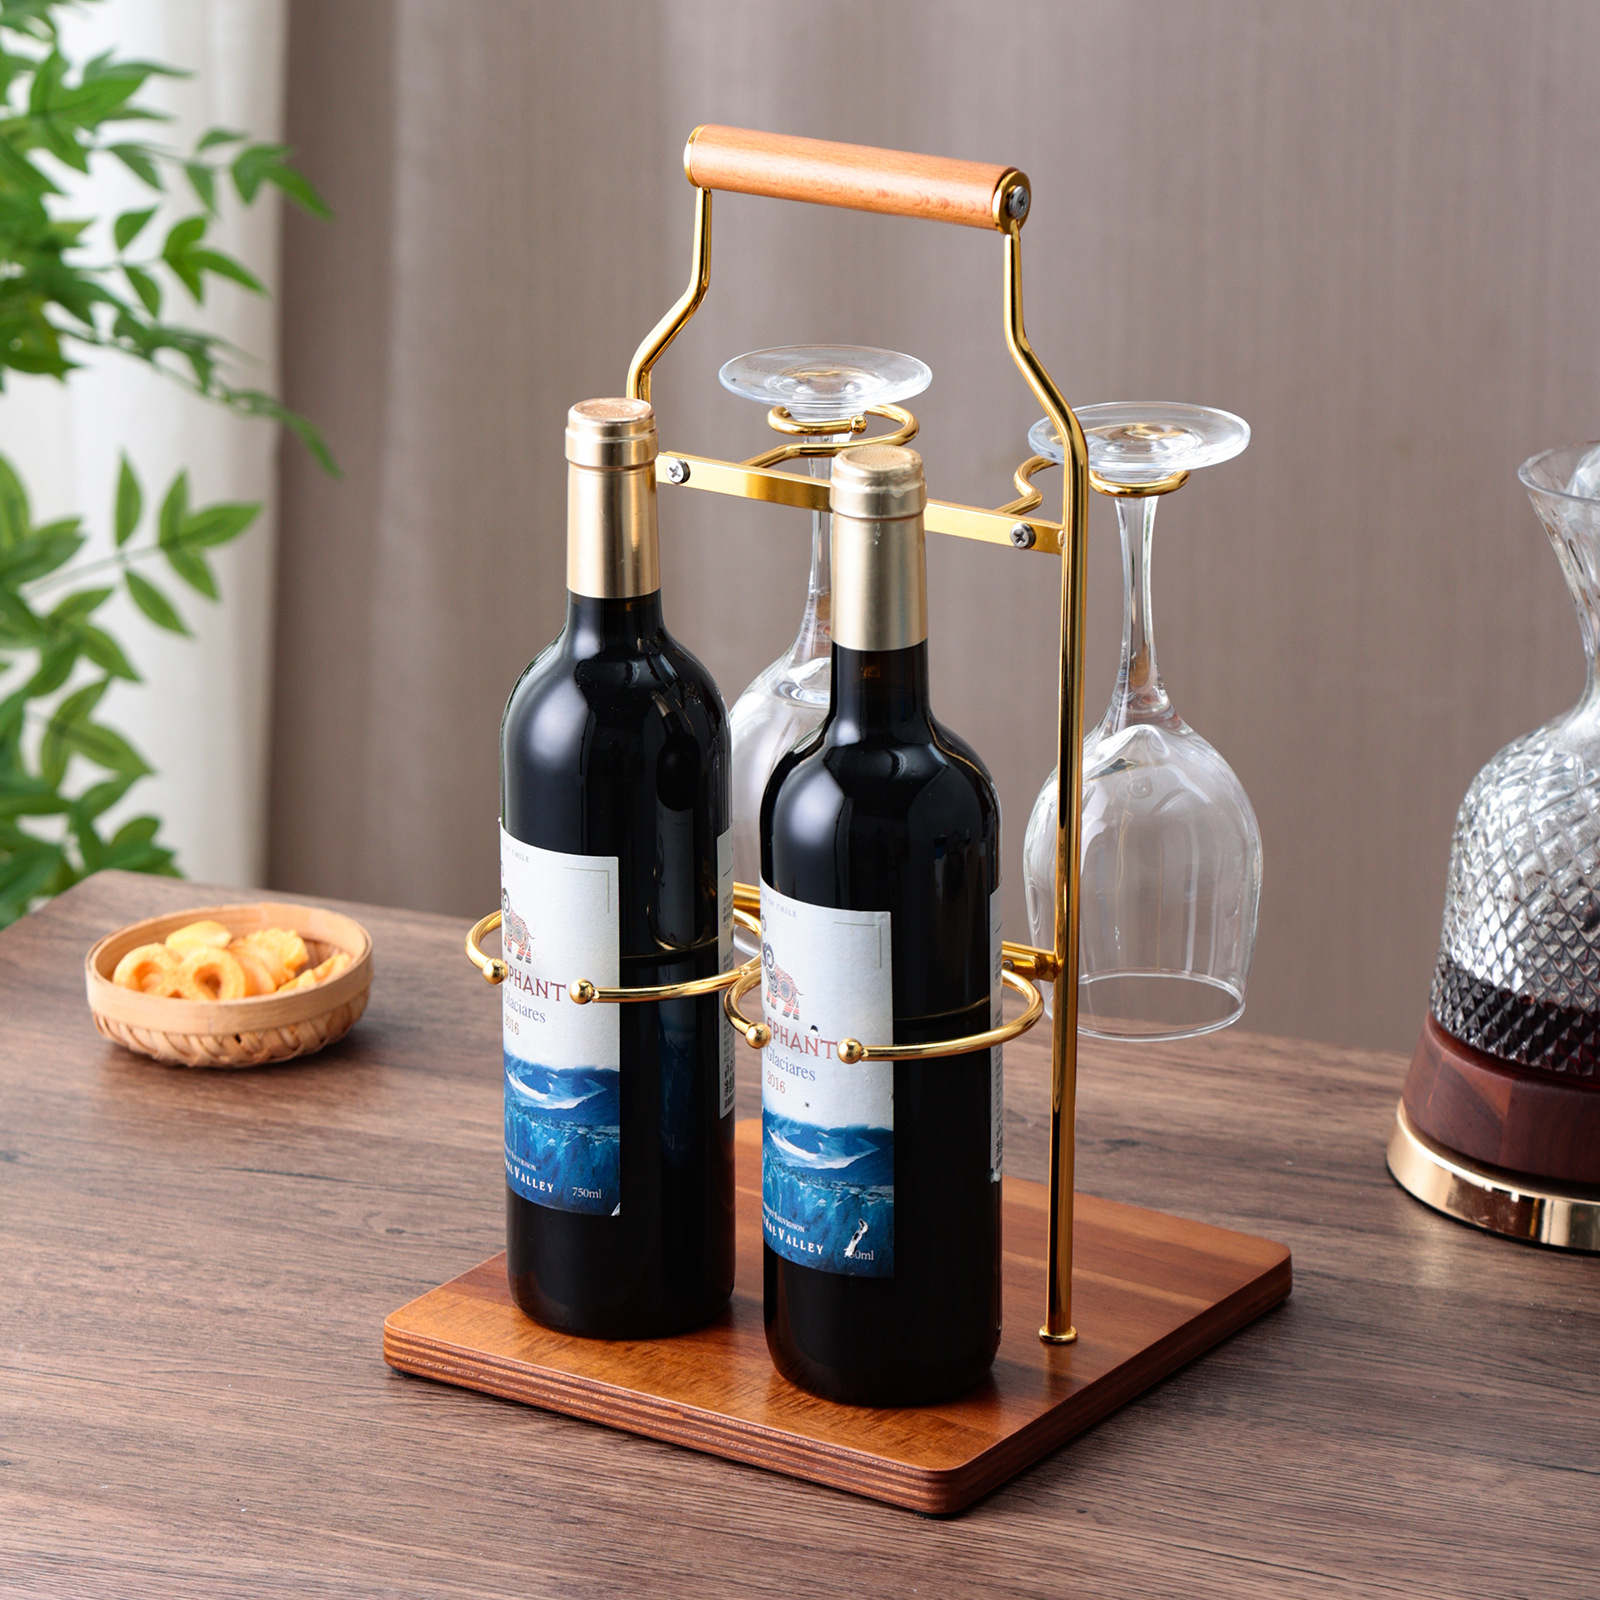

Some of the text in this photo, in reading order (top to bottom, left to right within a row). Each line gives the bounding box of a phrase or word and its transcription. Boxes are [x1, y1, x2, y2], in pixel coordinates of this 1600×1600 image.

[776, 904, 797, 918] CHILE
[505, 961, 567, 1002] PHANT
[766, 1045, 816, 1082] Glaciares
[766, 1070, 786, 1095] 2016
[572, 1186, 602, 1199] 750ml
[844, 1249, 875, 1261] 0ml
